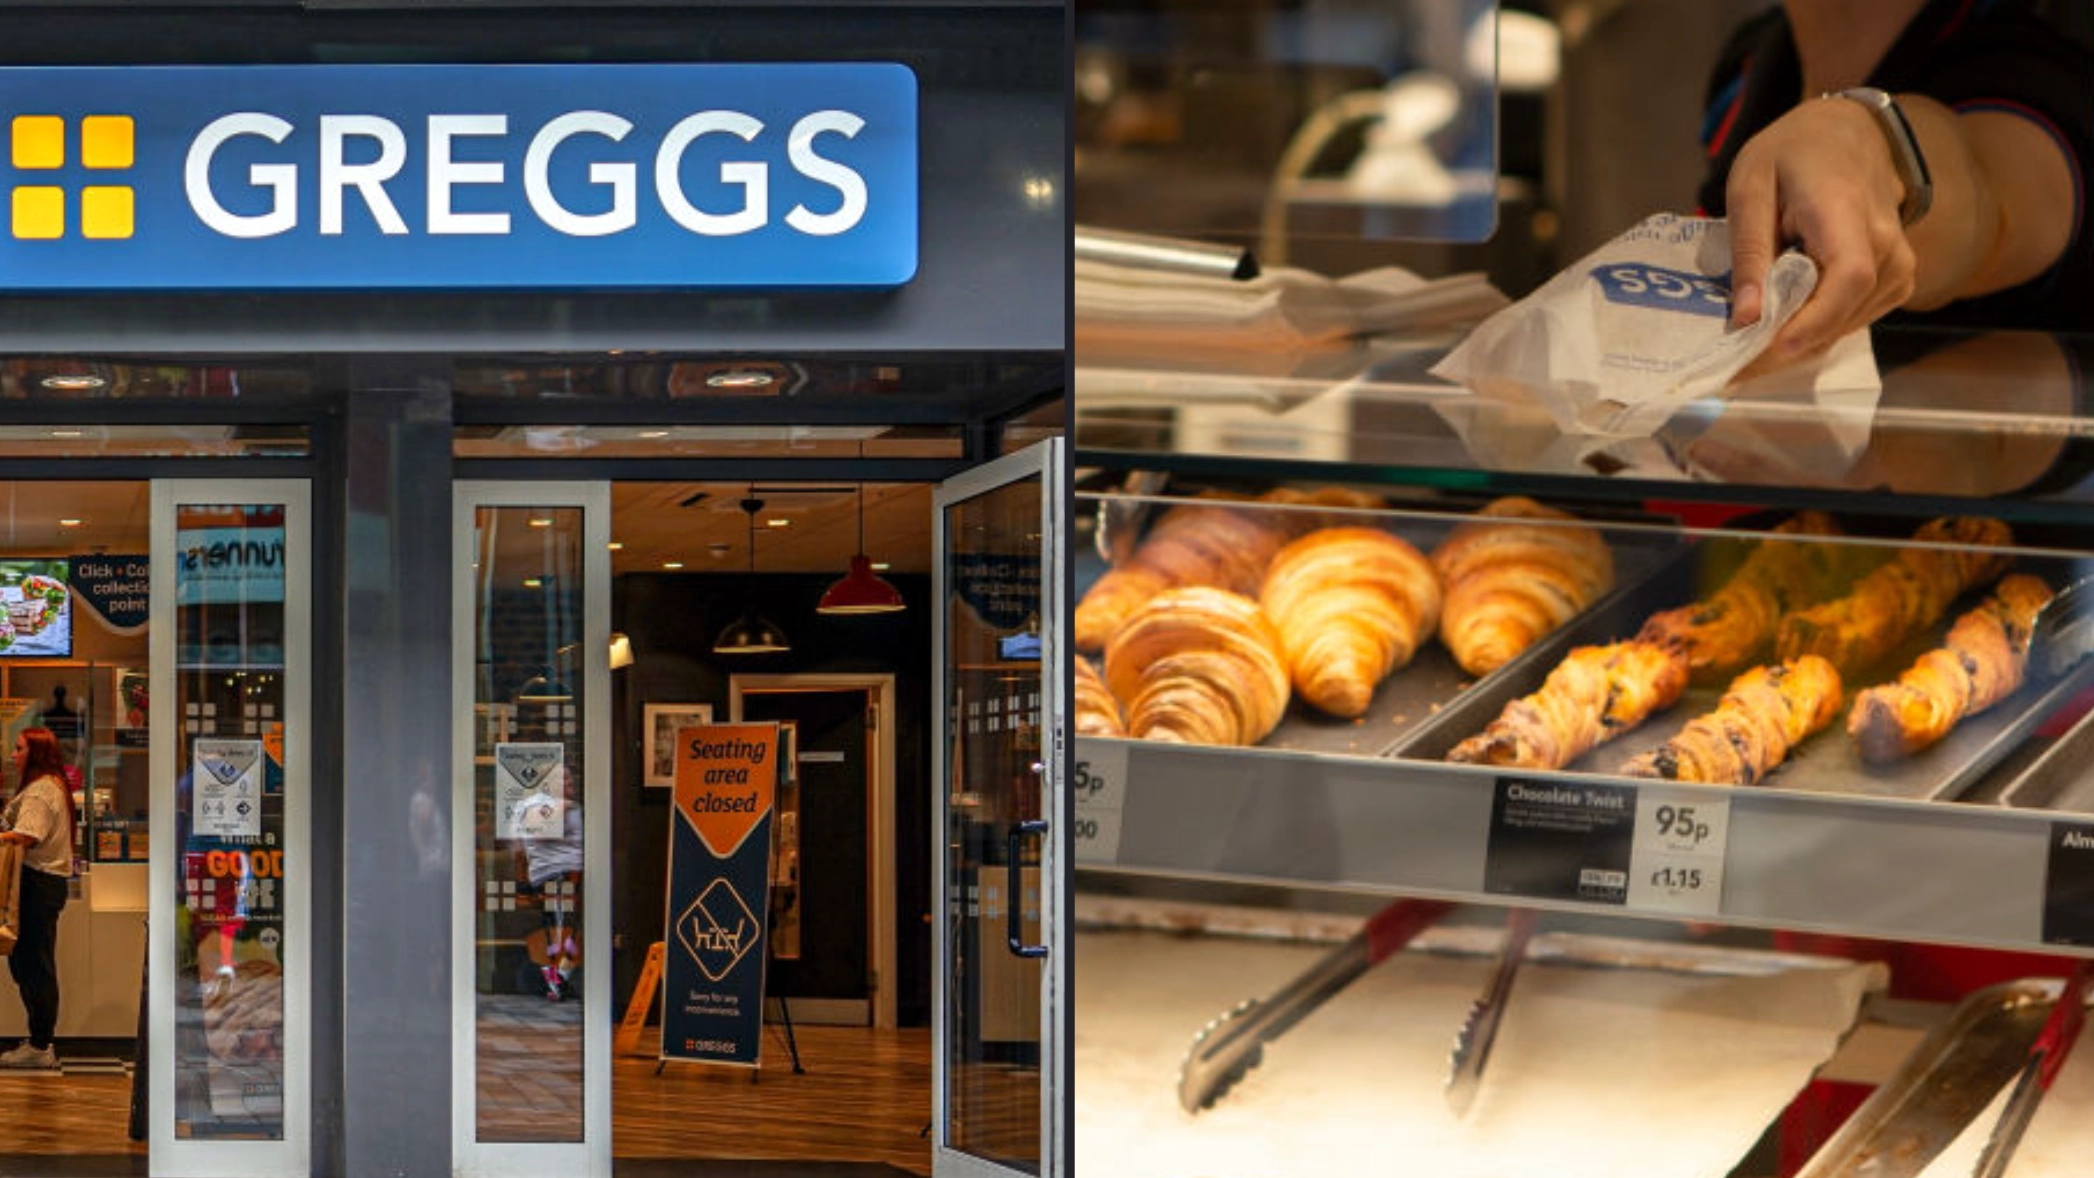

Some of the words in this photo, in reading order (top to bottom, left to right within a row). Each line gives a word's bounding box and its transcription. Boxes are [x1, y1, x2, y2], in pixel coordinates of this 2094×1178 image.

[183, 110, 869, 238] GREGGS
[79, 563, 113, 578] Click
[109, 597, 146, 613] point
[690, 738, 766, 764] Seating
[704, 769, 749, 785] area
[692, 791, 757, 813] closed
[1507, 784, 1581, 805] Chocolate
[1586, 791, 1626, 809] Twist
[1656, 804, 1710, 842] 95p
[1651, 866, 1701, 890] £1.15
